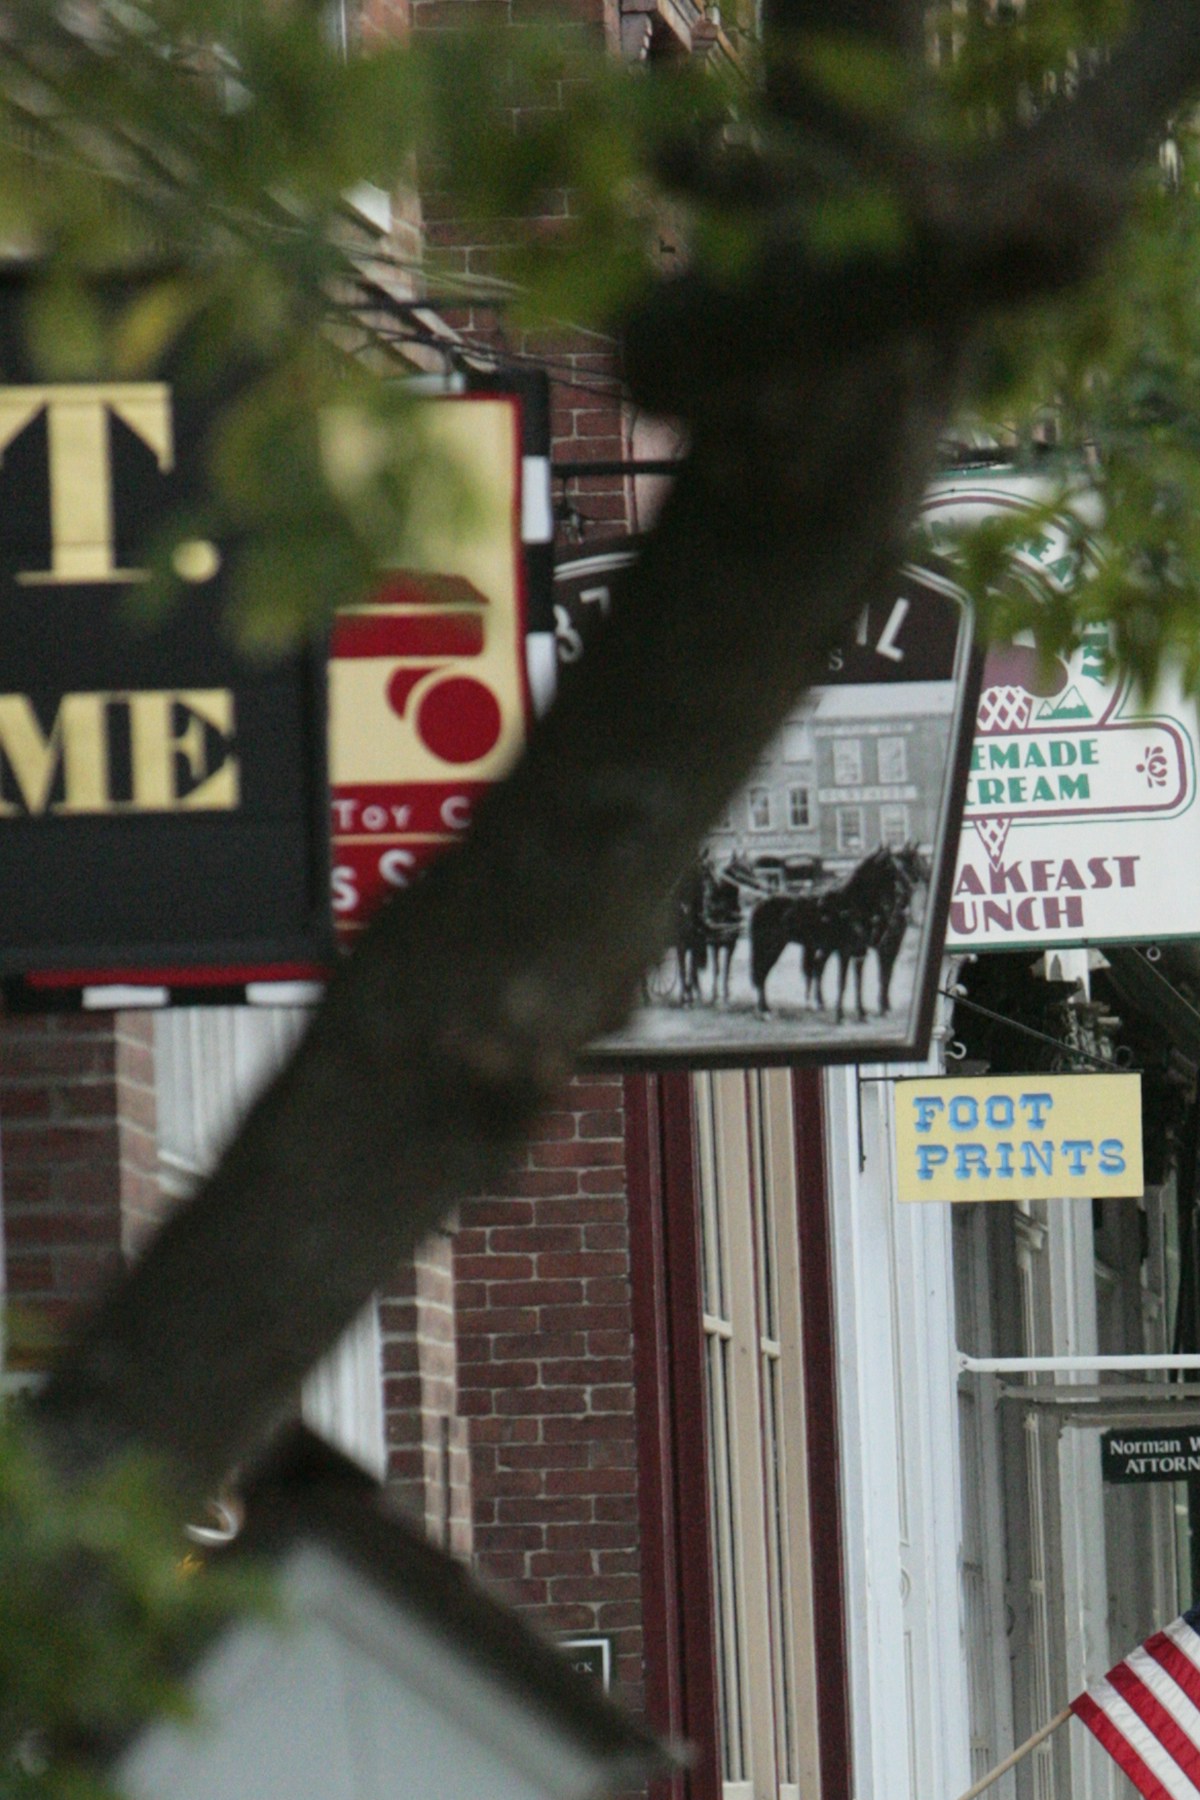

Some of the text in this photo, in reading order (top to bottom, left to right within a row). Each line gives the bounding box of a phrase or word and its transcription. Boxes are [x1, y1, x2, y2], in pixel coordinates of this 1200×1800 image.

[969, 738, 1099, 771] EMADE
[954, 855, 1141, 896] AKFAST
[949, 895, 1085, 934] UNCH
[912, 1092, 1054, 1133] FOOT
[915, 1138, 1127, 1181] PRINTS
[1109, 1439, 1182, 1456] Norman
